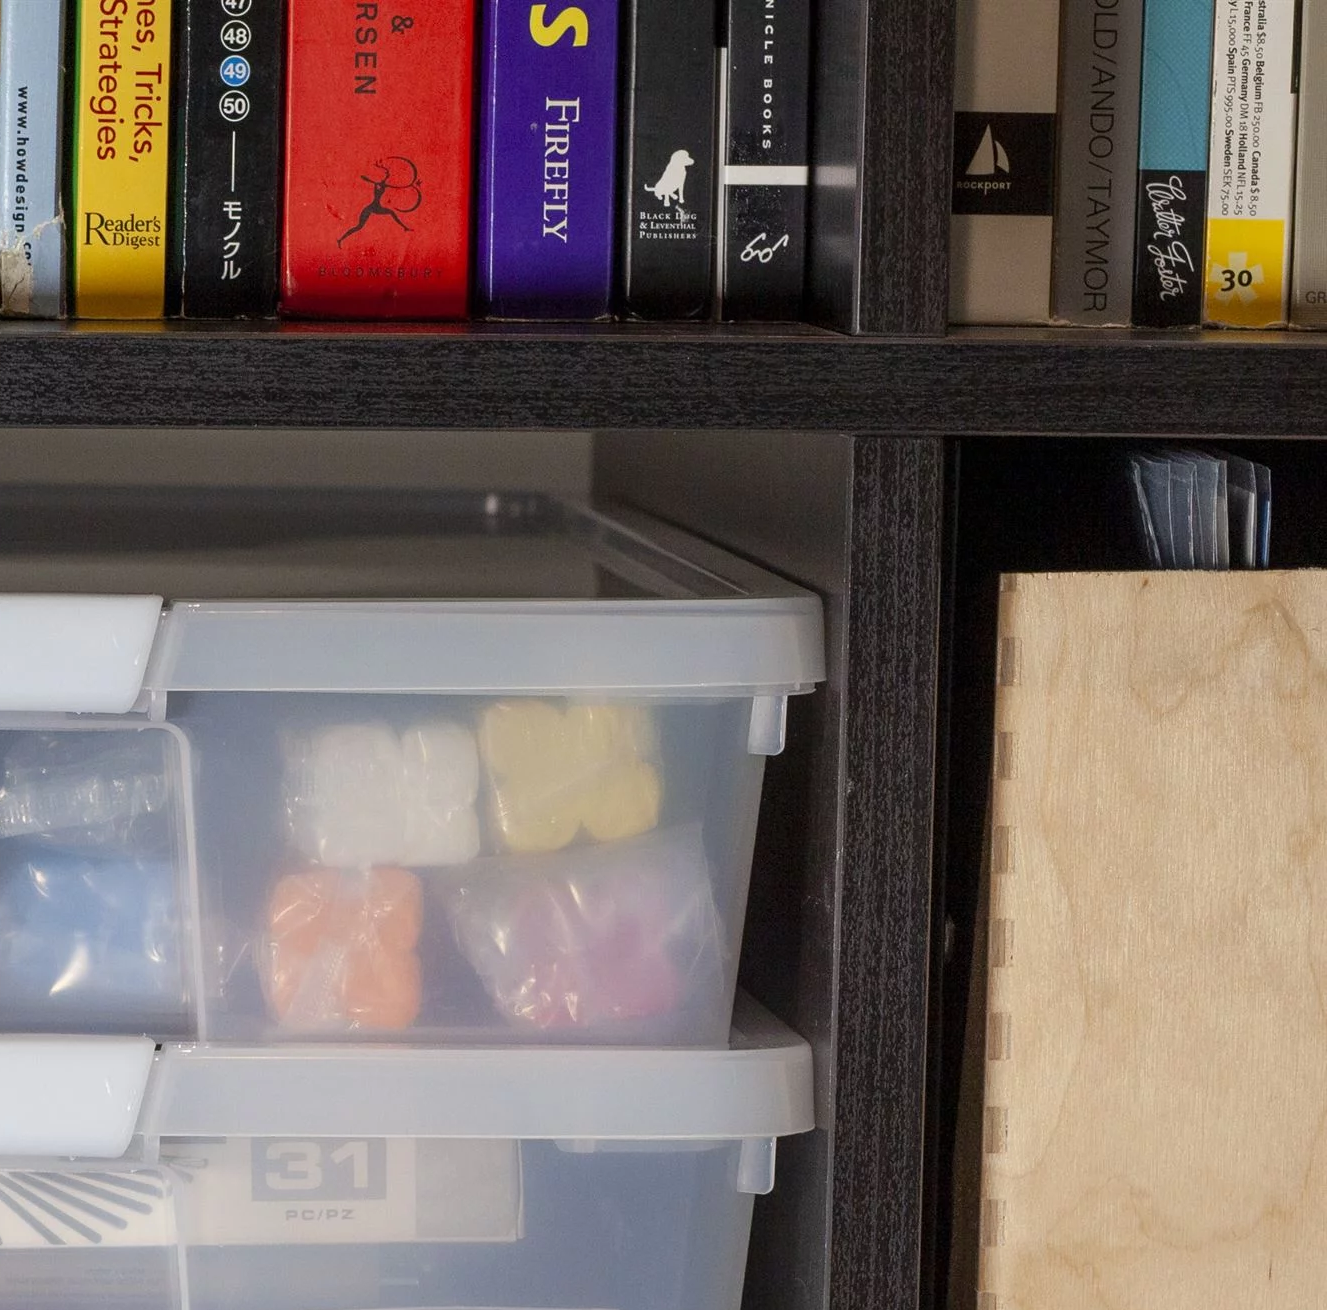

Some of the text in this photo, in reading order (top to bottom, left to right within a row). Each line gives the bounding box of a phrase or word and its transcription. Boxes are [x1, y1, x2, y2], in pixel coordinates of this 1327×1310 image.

[392, 15, 414, 34] &
[529, 4, 589, 47] S
[1243, 1, 1254, 32] France
[354, 2, 378, 95] RSEN
[1240, 45, 1250, 57] 45
[1243, 33, 1252, 44] FF
[762, 0, 774, 149] NICLE BOOKS
[1226, 47, 1238, 74] Spain
[90, 0, 128, 160] Strategies
[1226, 76, 1237, 94] PTS
[1238, 58, 1251, 102] Germany
[1253, 60, 1265, 100] Belgium
[129, 63, 162, 162] Tricks,
[1240, 103, 1250, 119] DM
[1254, 102, 1263, 114] FB
[1239, 121, 1248, 131] 18
[1251, 115, 1261, 148] 250.00
[1223, 129, 1234, 167] Sweden
[1237, 133, 1248, 170] Holland
[542, 96, 580, 243] FIREFLY
[1222, 168, 1232, 188] SEK
[1236, 172, 1246, 189] NFL
[1250, 150, 1261, 186] Canada
[84, 212, 161, 246] Reader's
[113, 233, 161, 249] Digest
[221, 201, 242, 280] モノクル
[639, 221, 648, 230] &
[1145, 175, 1194, 301] Walter Foster
[1221, 269, 1252, 292] 30
[265, 1141, 369, 1190] 31
[284, 1208, 356, 1221] PC/PZ
